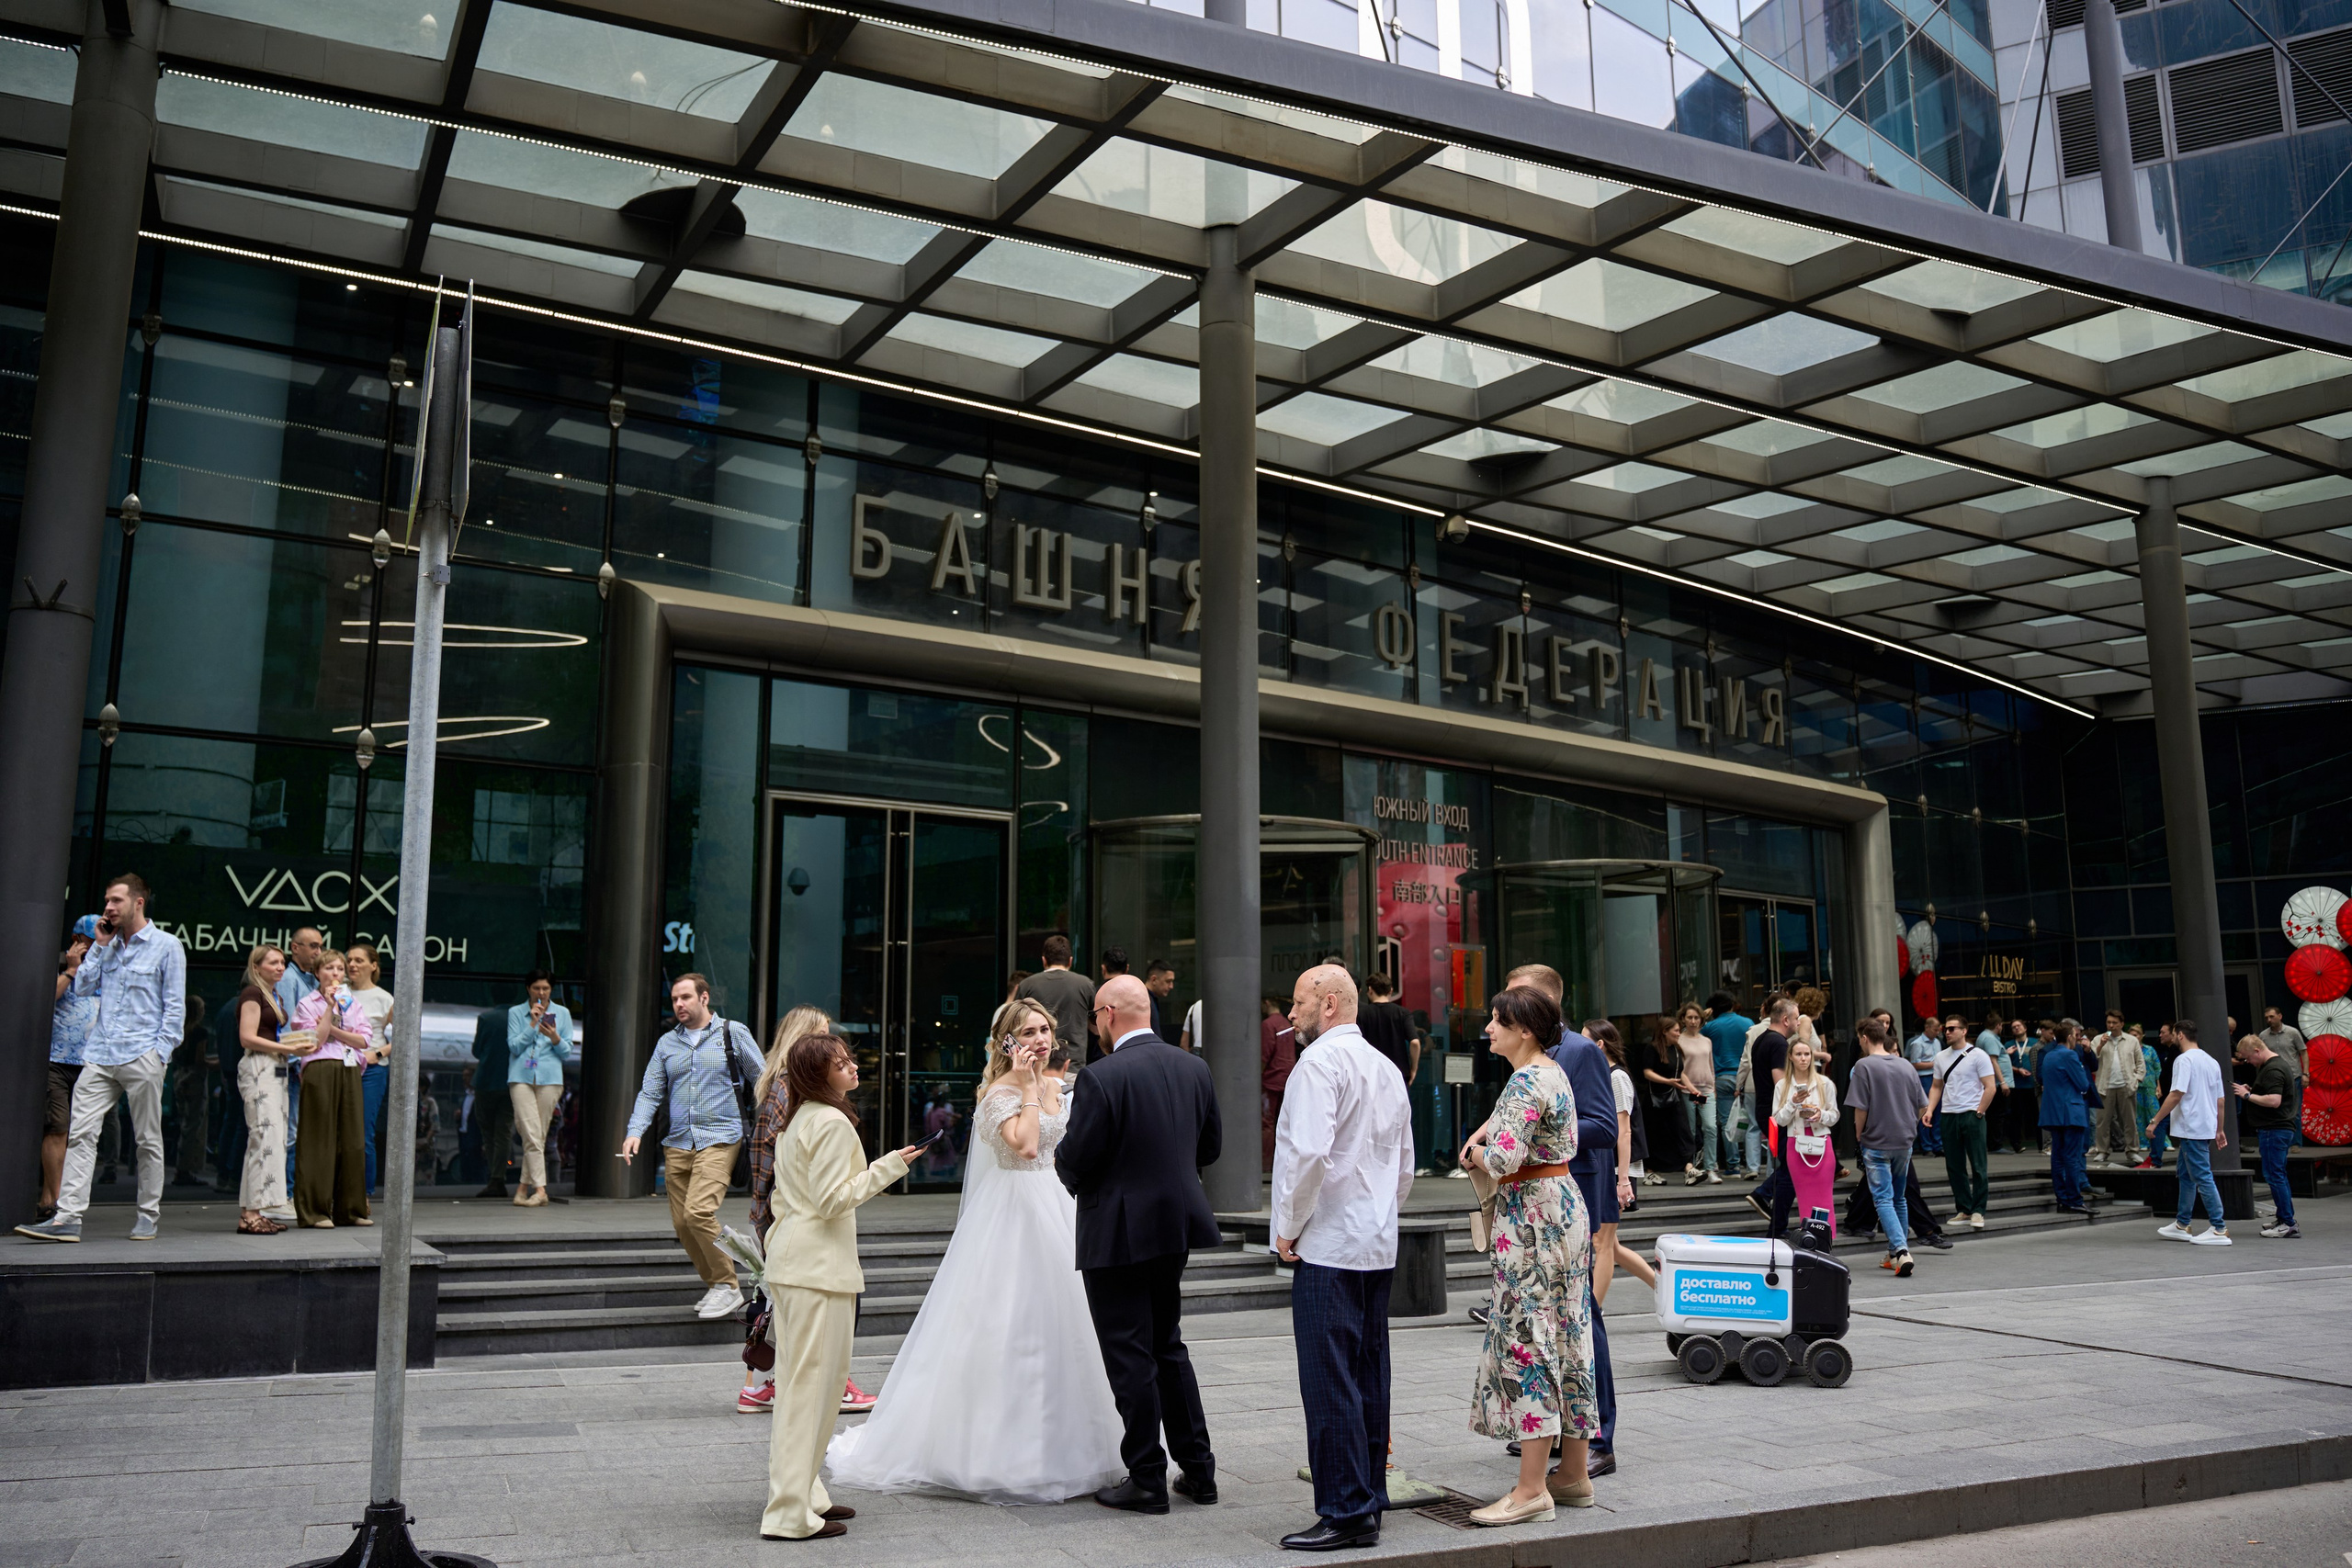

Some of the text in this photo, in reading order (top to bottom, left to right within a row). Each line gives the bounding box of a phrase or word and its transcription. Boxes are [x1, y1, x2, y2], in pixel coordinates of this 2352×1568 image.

[1374, 600, 1785, 747] ФЕДЕРАЦИЯ
[1374, 795, 1469, 832] ЮЖНЫЙ ВХОД
[1375, 839, 1479, 870] UTH ENTRANCE
[1393, 879, 1462, 906] 南部入口
[356, 931, 468, 963] АОН
[1993, 980, 2018, 994] BISTRO
[1810, 1223, 1825, 1231] A-492
[1679, 1278, 1752, 1291] доставлю
[1679, 1290, 1757, 1305] бесплатно
